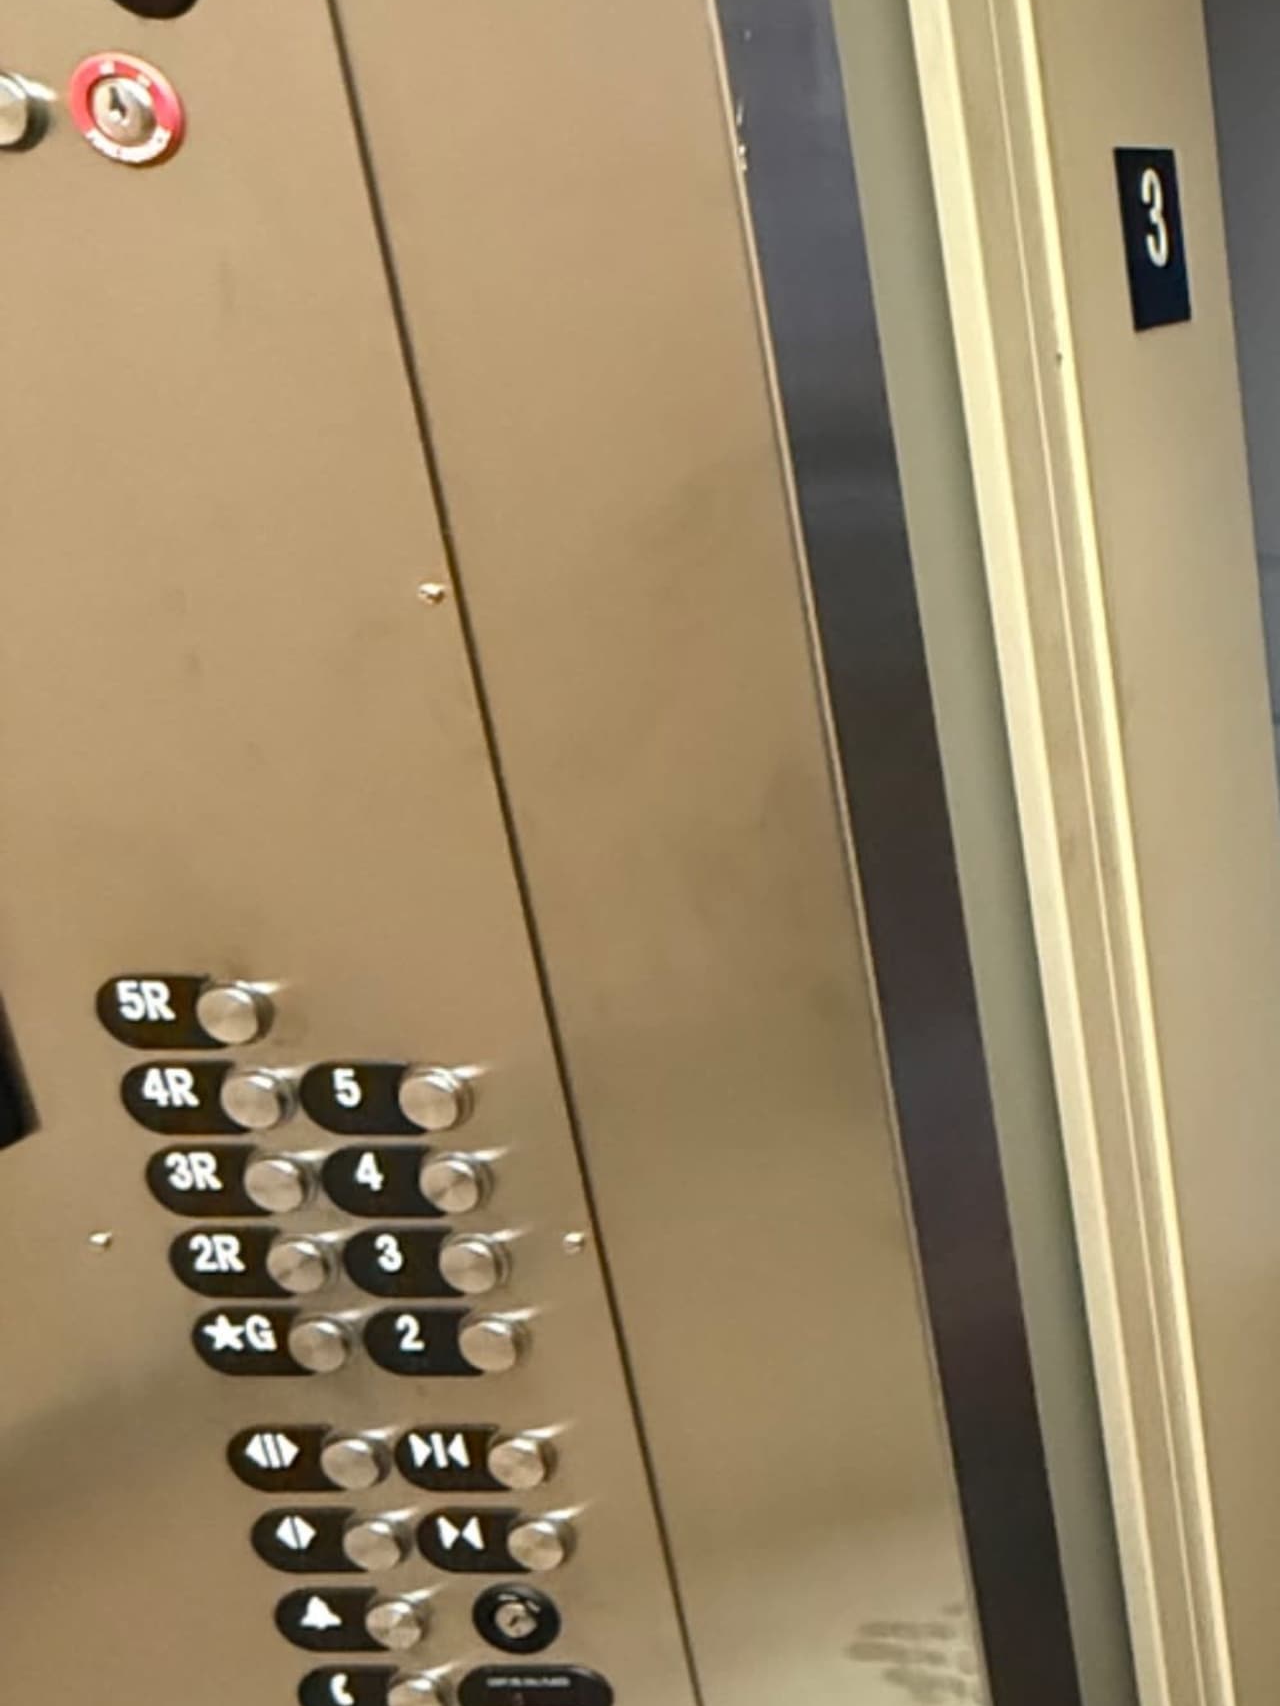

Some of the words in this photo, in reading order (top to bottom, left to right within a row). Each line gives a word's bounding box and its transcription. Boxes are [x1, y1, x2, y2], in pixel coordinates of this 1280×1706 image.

[1141, 167, 1169, 269] 3
[117, 980, 176, 1021] 5R
[142, 1067, 199, 1107] 4R
[333, 1068, 362, 1107] 5
[165, 1151, 222, 1191] 3R
[355, 1152, 384, 1191] 4
[188, 1234, 245, 1272] 2R
[374, 1234, 403, 1272] 3
[394, 1314, 425, 1351] 2
